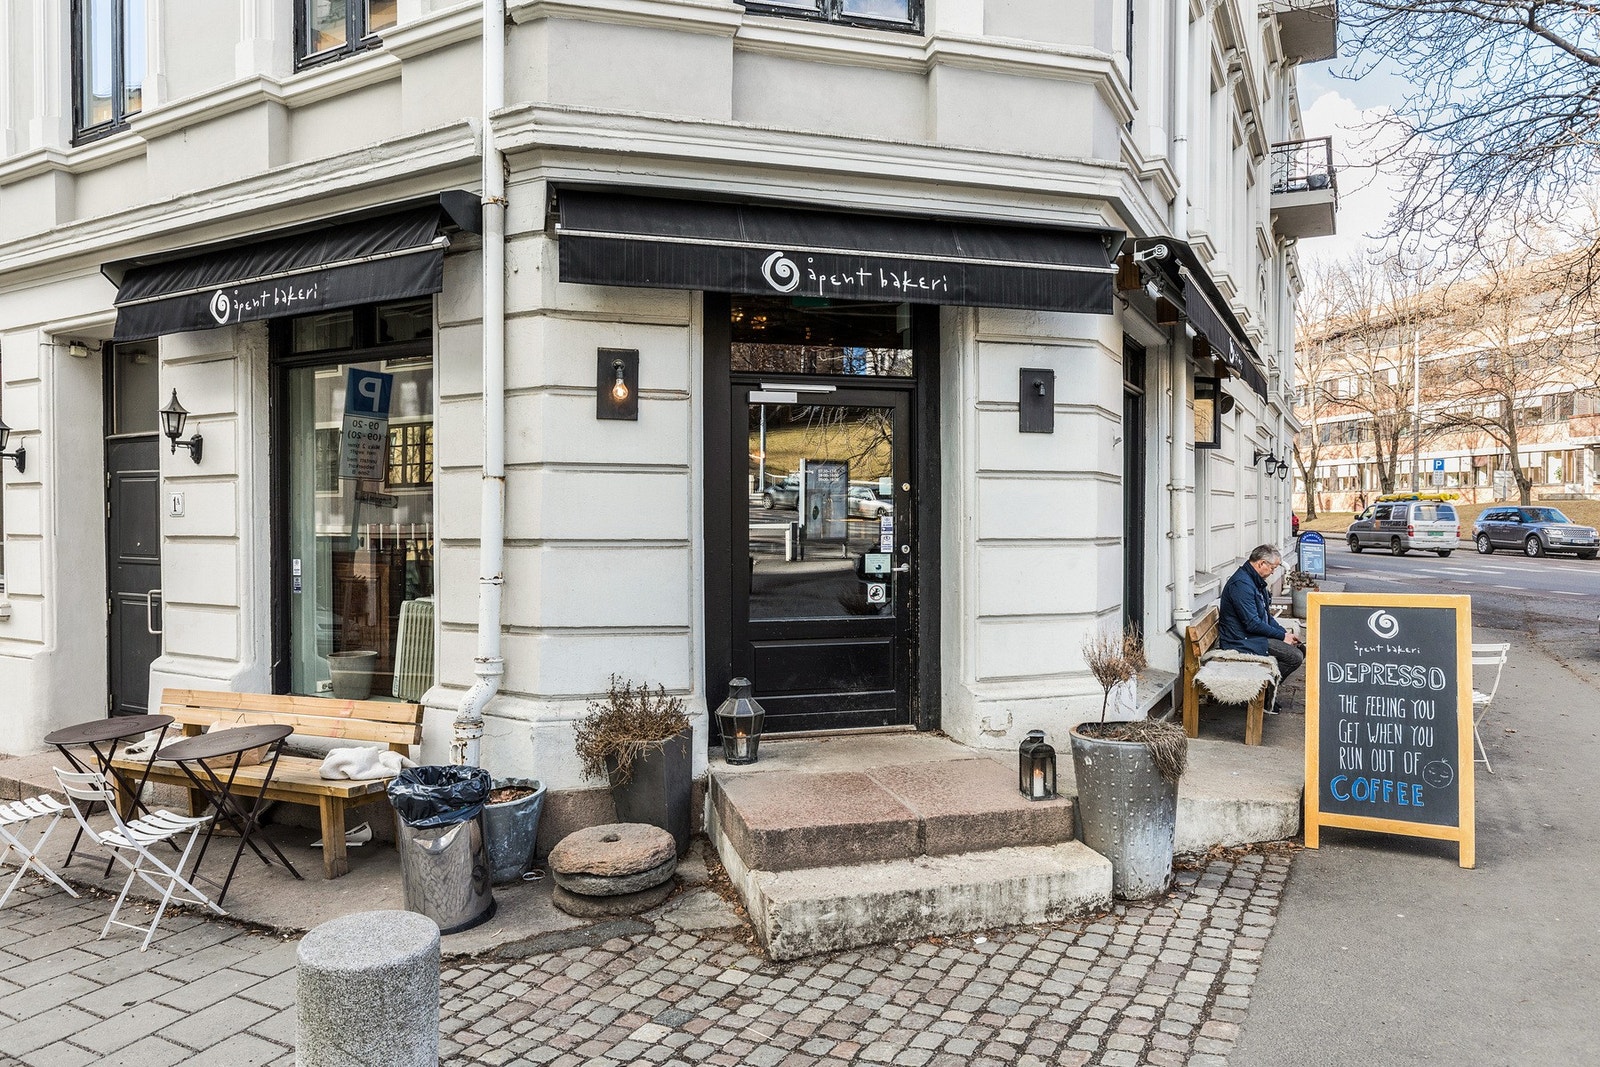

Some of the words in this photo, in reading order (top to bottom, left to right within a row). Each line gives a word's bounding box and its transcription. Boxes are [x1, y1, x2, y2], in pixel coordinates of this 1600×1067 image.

[808, 257, 872, 296] åpent
[880, 268, 948, 293] bakeri
[233, 289, 271, 322] åpent
[274, 283, 318, 306] bakeri
[1435, 460, 1443, 470] P
[1354, 641, 1384, 656] åpent
[1387, 644, 1421, 655] bakeri
[1326, 661, 1446, 691] DEPRESSO
[1338, 694, 1359, 714] THE
[1365, 695, 1406, 719] FEELING
[1410, 699, 1435, 720] YOU
[1338, 718, 1360, 745] GET
[1366, 722, 1402, 745] WHEN
[1410, 725, 1434, 748] YOU
[1339, 746, 1363, 770] RUN
[1371, 748, 1395, 773] OUT
[1403, 750, 1422, 776] OF
[1330, 774, 1425, 807] COFFEE
